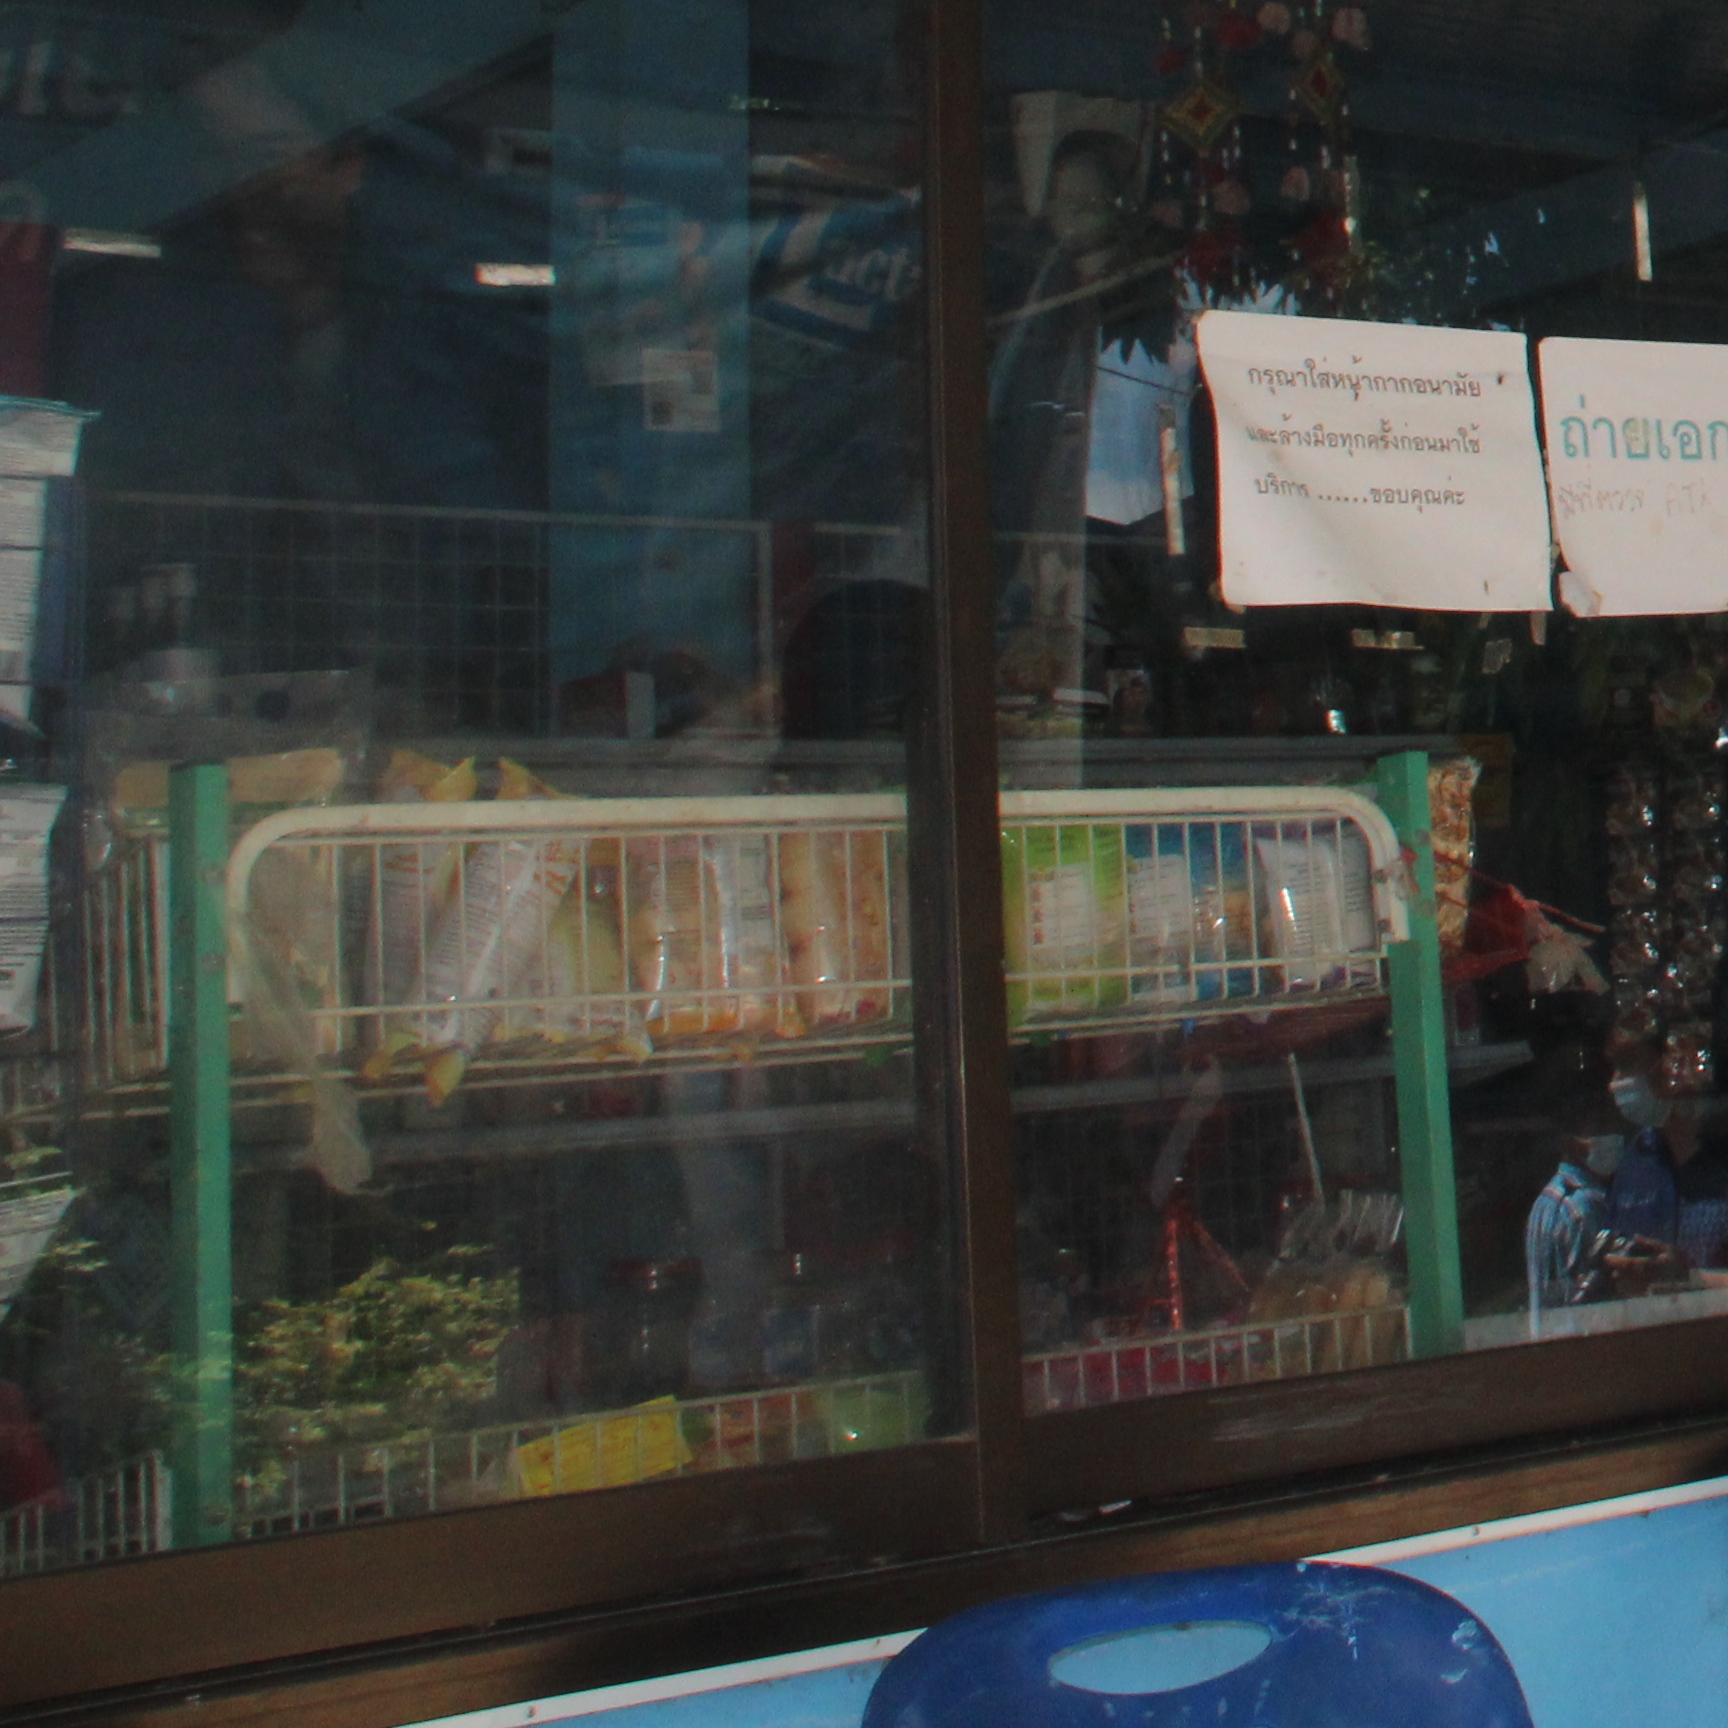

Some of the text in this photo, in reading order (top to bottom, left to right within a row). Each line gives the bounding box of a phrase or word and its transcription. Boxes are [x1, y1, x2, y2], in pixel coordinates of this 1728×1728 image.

[1248, 354, 1482, 401] กรุณาใส่หน้ากากอนามัย
[1254, 473, 1311, 498] บริการ
